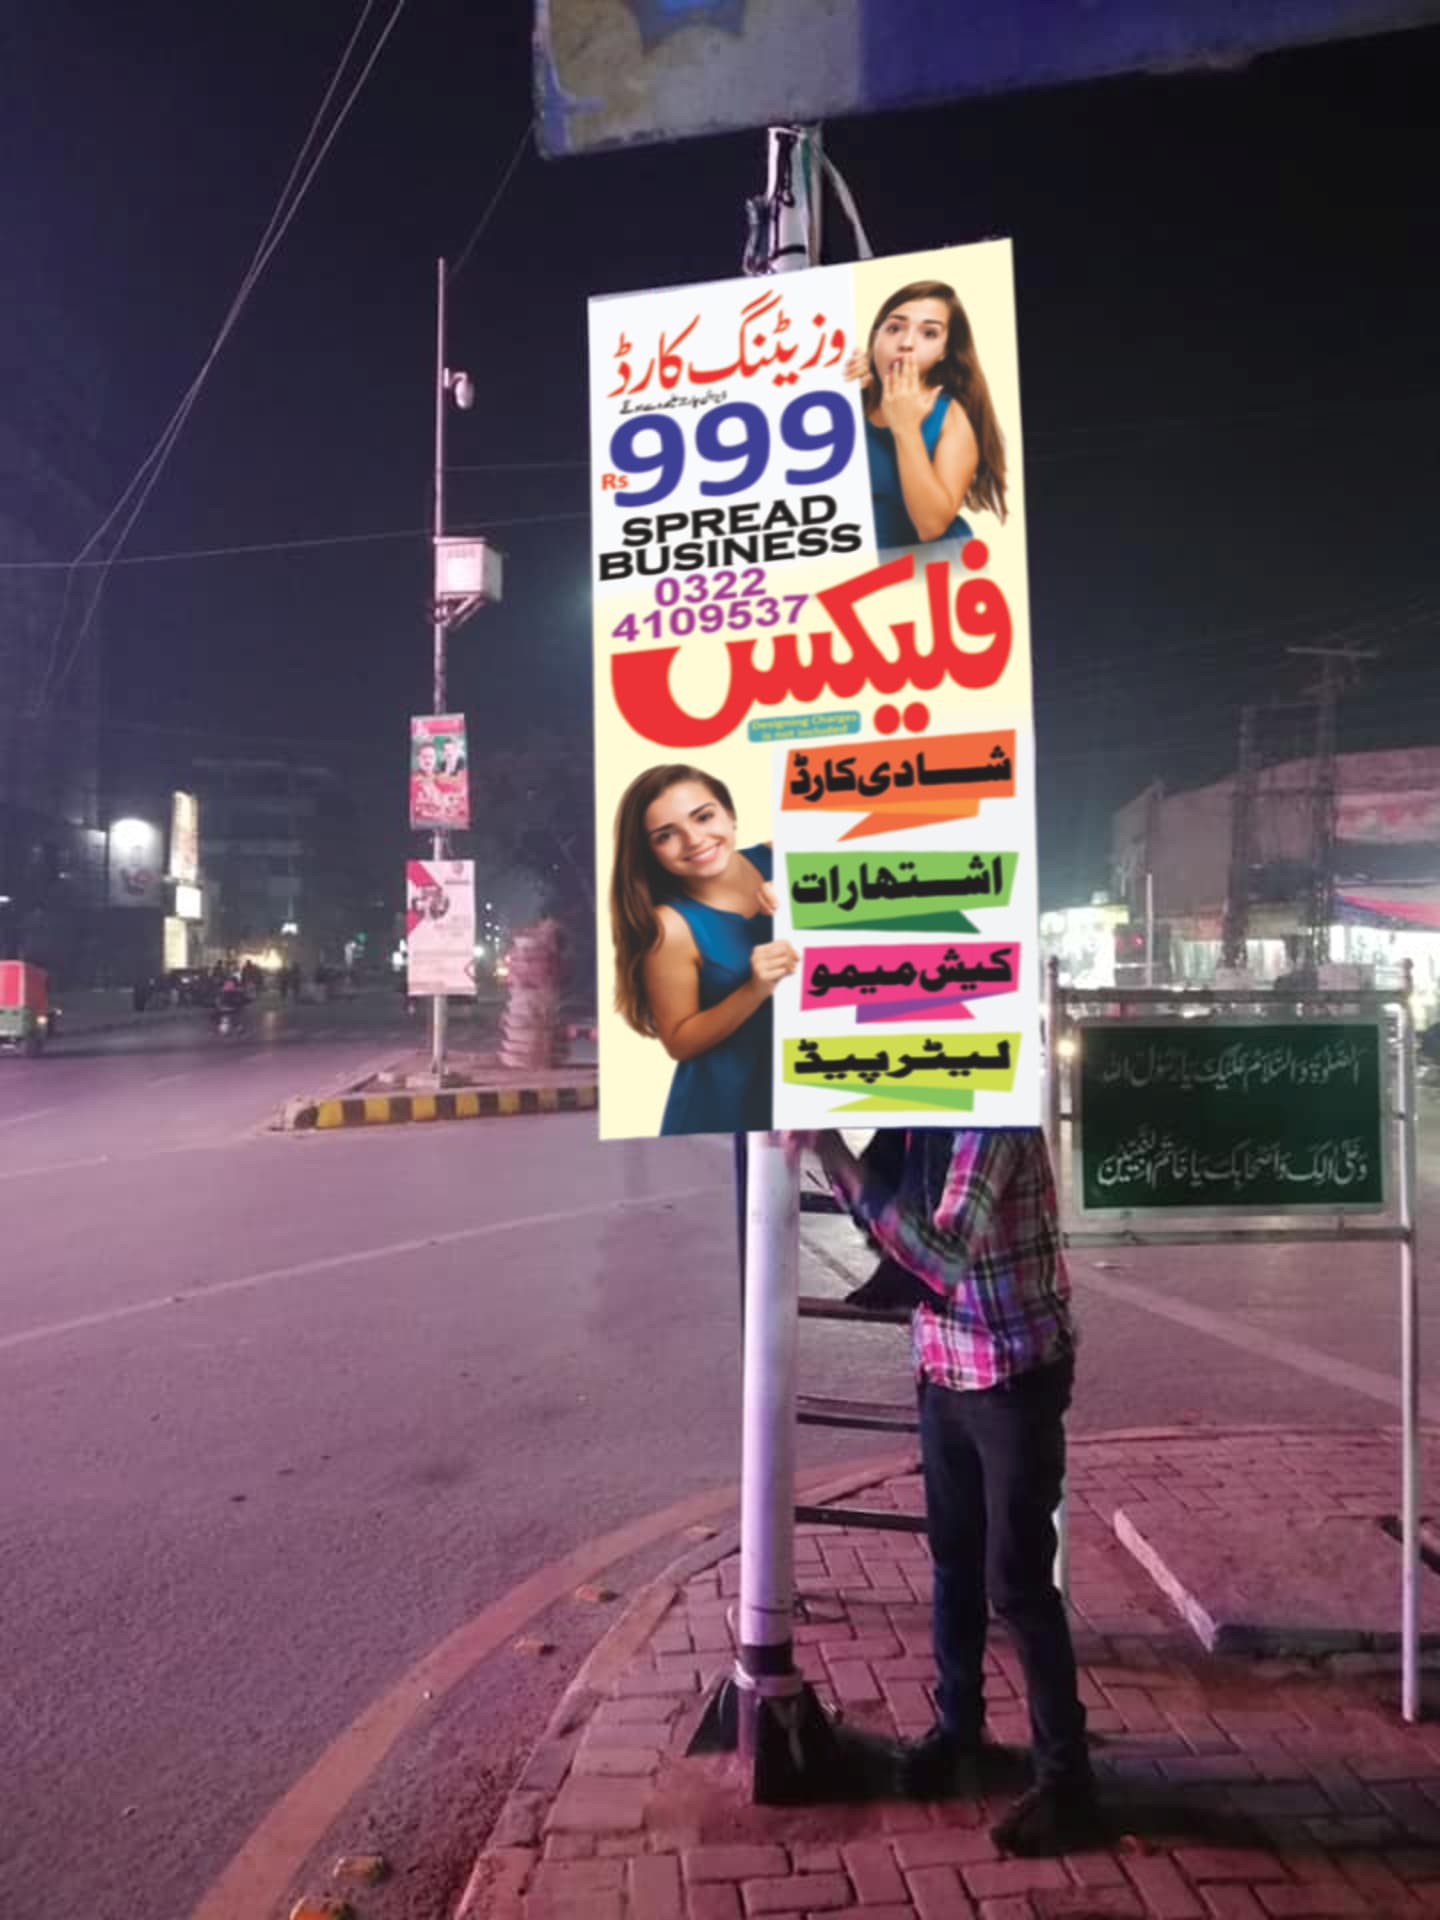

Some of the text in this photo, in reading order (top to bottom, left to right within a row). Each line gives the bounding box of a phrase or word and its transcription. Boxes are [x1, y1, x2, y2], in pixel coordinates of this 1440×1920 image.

[608, 293, 845, 397] وزیٹنگ کارڈ
[602, 390, 856, 508] Rs 999
[622, 495, 837, 547] SPREAD
[599, 523, 862, 581] BUSINESS
[655, 567, 766, 607] 0322
[612, 594, 809, 641] 4109537
[611, 539, 1015, 749] فلیکس
[751, 717, 809, 731] Designing
[790, 754, 857, 802] کارڈ
[809, 962, 918, 997] میمو
